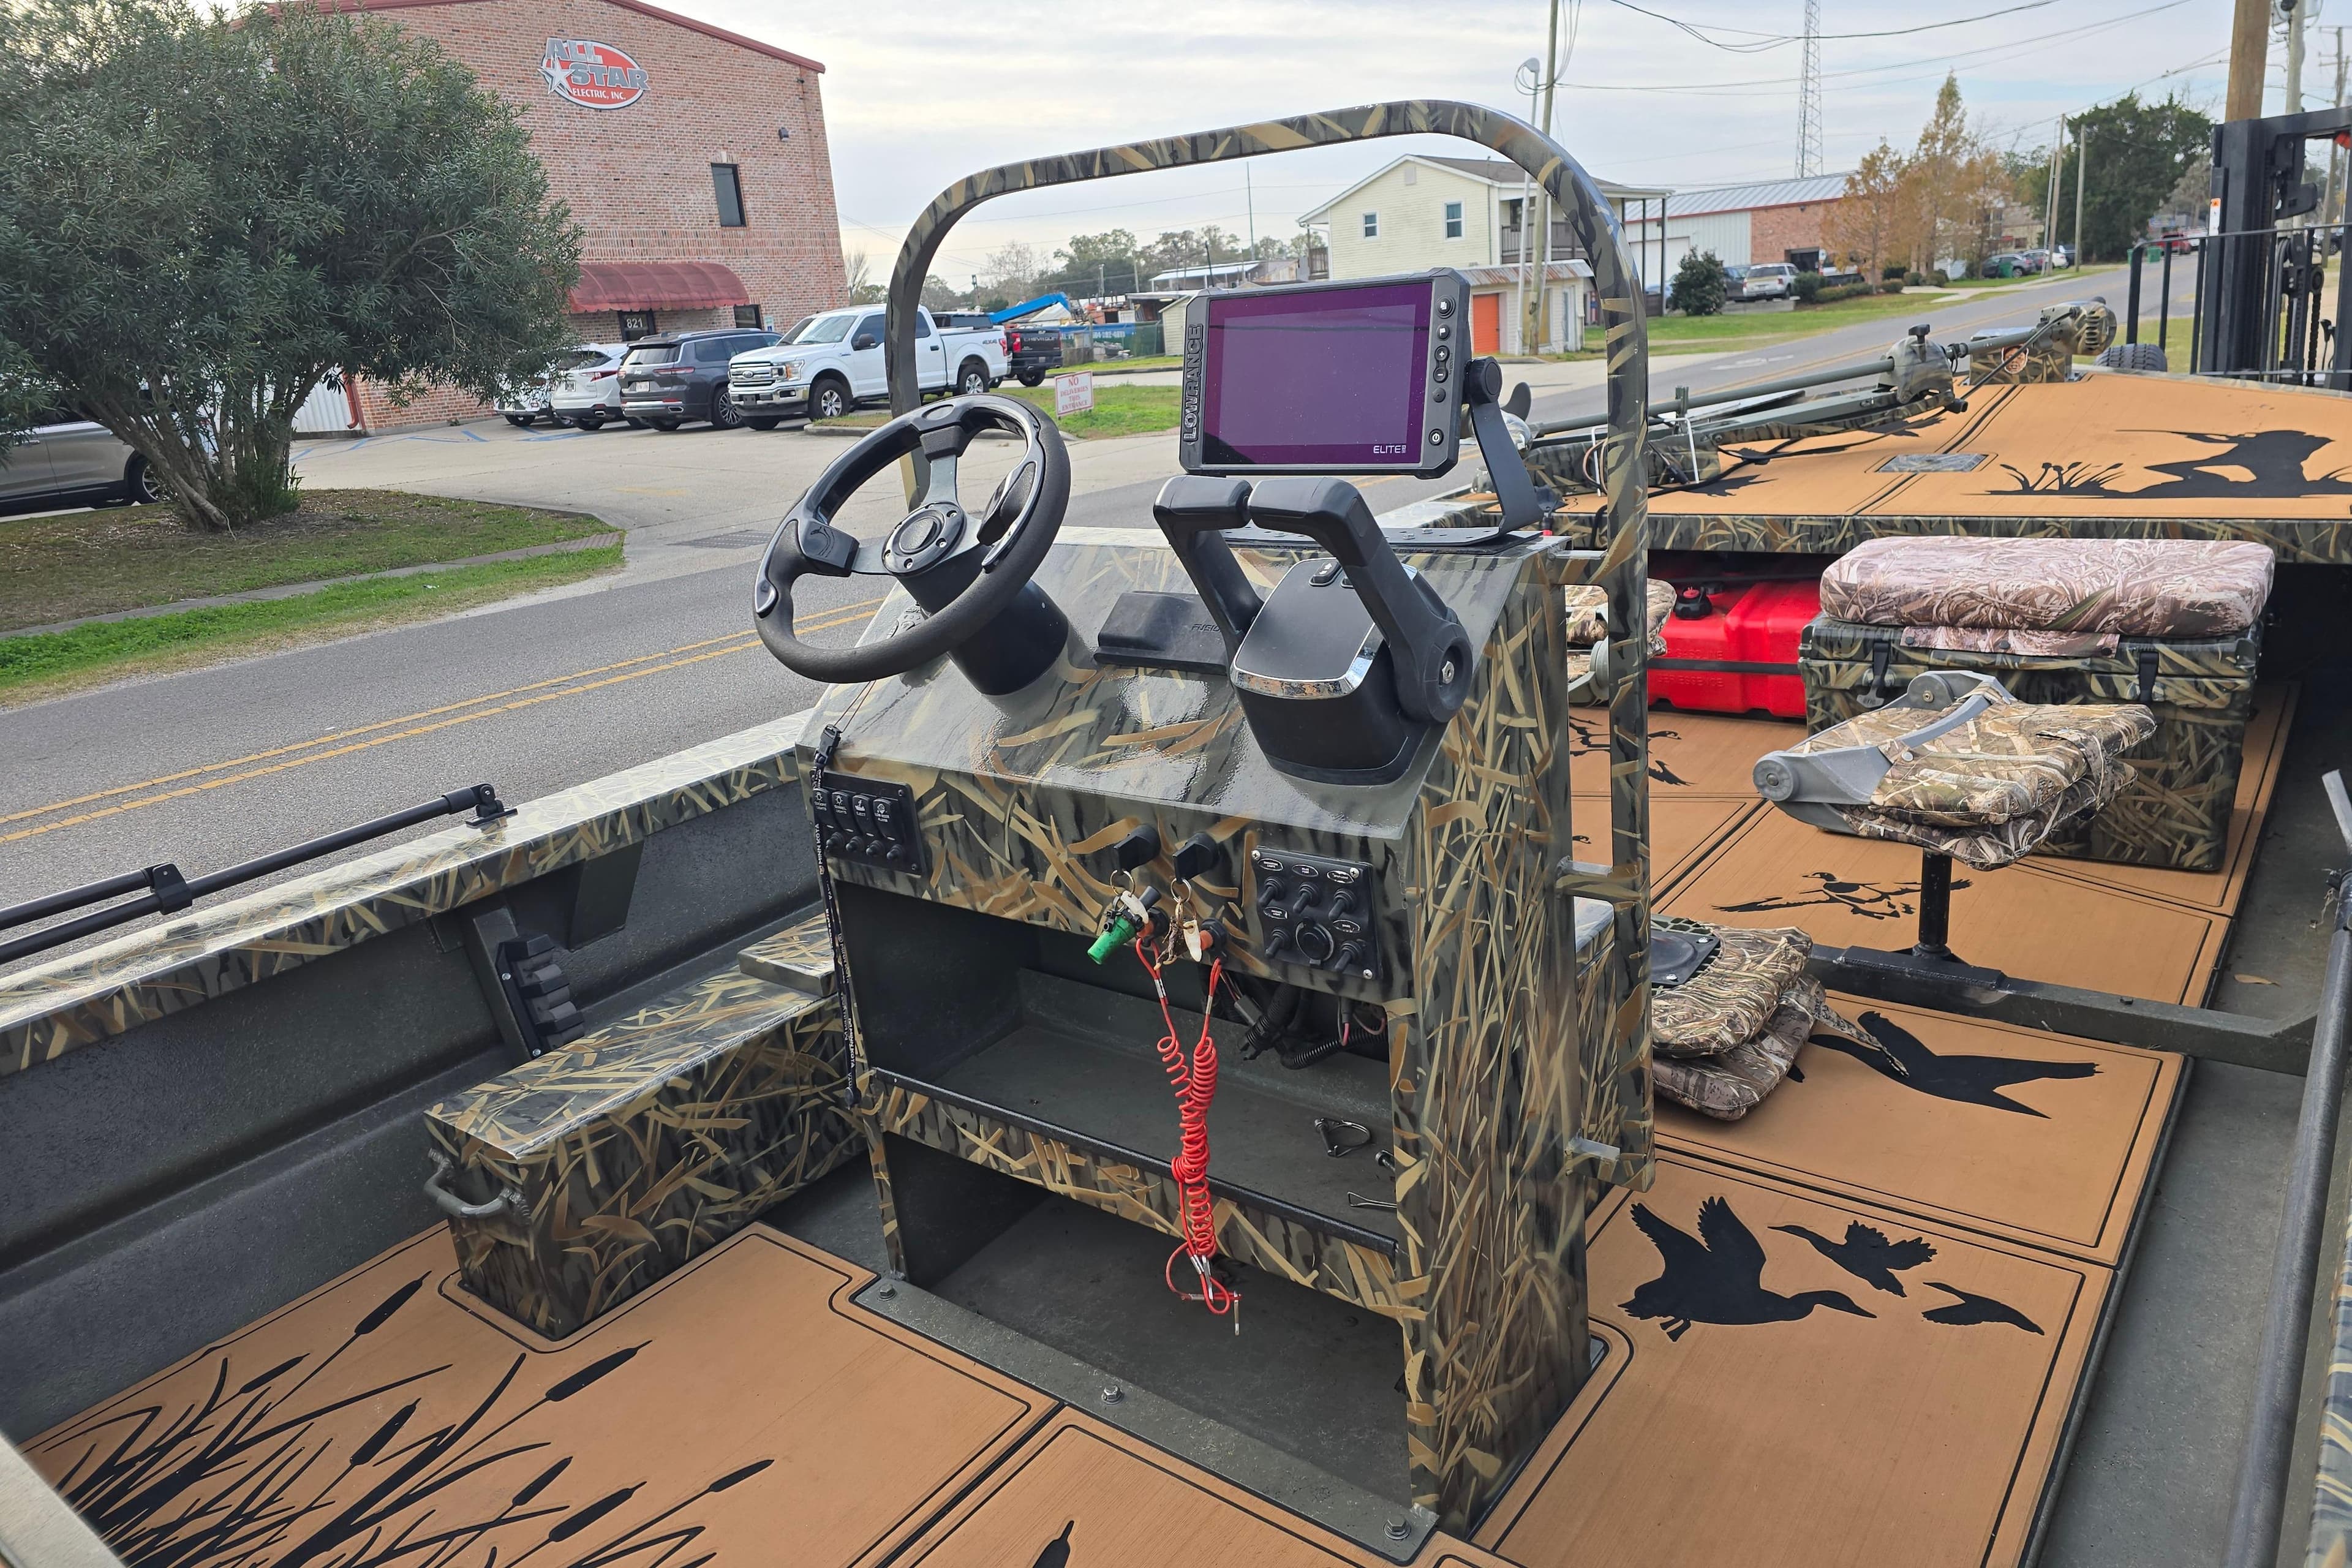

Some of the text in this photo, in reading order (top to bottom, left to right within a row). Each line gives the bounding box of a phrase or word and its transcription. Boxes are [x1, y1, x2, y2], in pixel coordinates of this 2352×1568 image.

[546, 37, 603, 64] ALL
[569, 62, 650, 90] STAR
[573, 88, 626, 100] ELECTRIC, INC.
[627, 318, 643, 328] 821
[1068, 377, 1079, 386] NO
[1183, 326, 1202, 440] LOWRANCE
[1060, 386, 1088, 397] DELIVERIES
[1062, 399, 1087, 410] ENTRANCE
